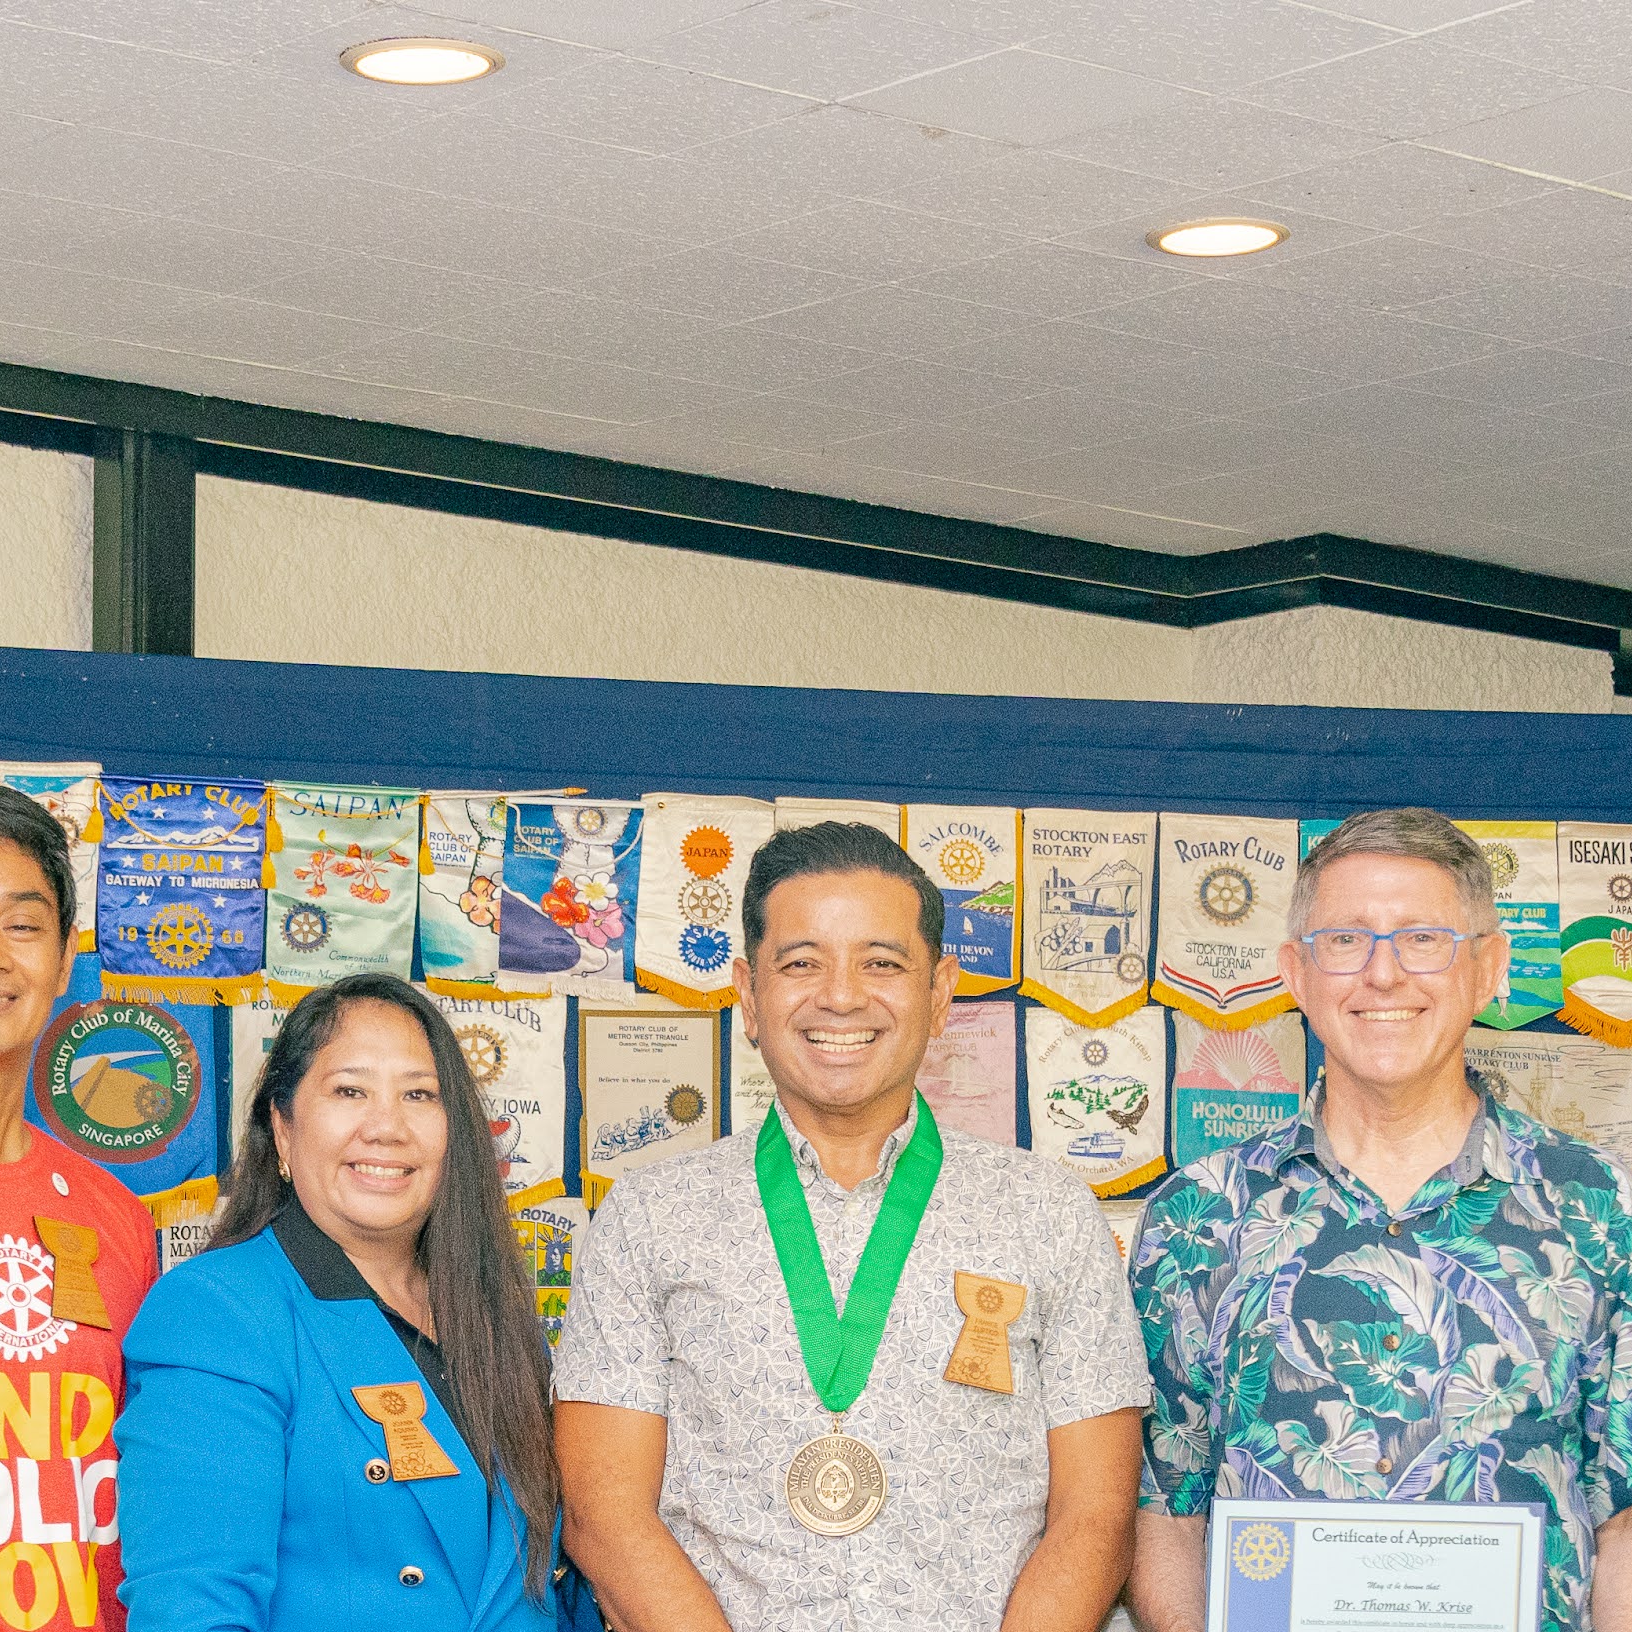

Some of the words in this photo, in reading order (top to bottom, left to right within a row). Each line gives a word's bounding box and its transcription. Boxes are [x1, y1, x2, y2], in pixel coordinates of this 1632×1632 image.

[289, 791, 406, 821] SAIPAN
[428, 832, 473, 844] ROTARY
[513, 826, 556, 837] ROTARY
[1032, 828, 1109, 844] STOCKTON
[1112, 832, 1148, 845] EAST
[428, 842, 459, 854] CLUB
[460, 843, 474, 854] OF
[513, 835, 543, 847] CLUB
[545, 837, 559, 847] OF
[918, 821, 1005, 859] SALCOMBE
[428, 852, 467, 865] SAIPAN
[686, 846, 729, 858] JAPAN
[1032, 844, 1093, 858] ROTARY
[1173, 837, 1240, 865] ROTARY
[1243, 836, 1286, 872] CLUB
[1569, 839, 1627, 864] ISESAKI
[141, 853, 225, 874] SAIPAN
[105, 875, 163, 888] GATEWAY
[168, 876, 185, 888] TO
[190, 876, 259, 890] MICRONESIA
[686, 927, 725, 945] OSAKA
[328, 949, 390, 964] Commonwealth
[960, 944, 994, 956] DEVON
[1185, 942, 1237, 957] STOCKTON
[1240, 946, 1267, 959] EAST
[1196, 955, 1252, 970] CALIFORNIA
[436, 996, 483, 1014] TARY
[490, 999, 542, 1033] CLUB
[618, 1025, 645, 1033] ROTARY
[647, 1025, 666, 1033] CLUB
[607, 1033, 632, 1041] METRO
[634, 1033, 654, 1041] WEST
[655, 1034, 689, 1042] TRIANGLE
[51, 1039, 76, 1097] Rotary
[69, 1010, 109, 1040] Club
[113, 1008, 134, 1025] of
[134, 1011, 184, 1059] Marina
[171, 1060, 194, 1098] City
[1464, 1047, 1522, 1060] WARRENTON
[1522, 1052, 1562, 1064] SUNRISE
[1502, 1060, 1529, 1070] CLUB
[648, 1077, 661, 1085] you
[503, 1099, 542, 1115] IOWA
[1191, 1101, 1284, 1122] HONOLULU
[77, 1122, 164, 1148] SINGAPORE
[1057, 1155, 1076, 1171] Port
[1077, 1163, 1117, 1175] Orchard,
[1117, 1155, 1135, 1168] WA
[520, 1208, 578, 1232] ROTARY
[1311, 1527, 1387, 1545] Certificate
[1389, 1529, 1405, 1545] of
[1406, 1529, 1500, 1547] Appreciation
[1333, 1599, 1356, 1611] Dr.
[1360, 1599, 1411, 1612] Thomas
[1415, 1600, 1432, 1612] W.
[1437, 1601, 1474, 1614] Krise
